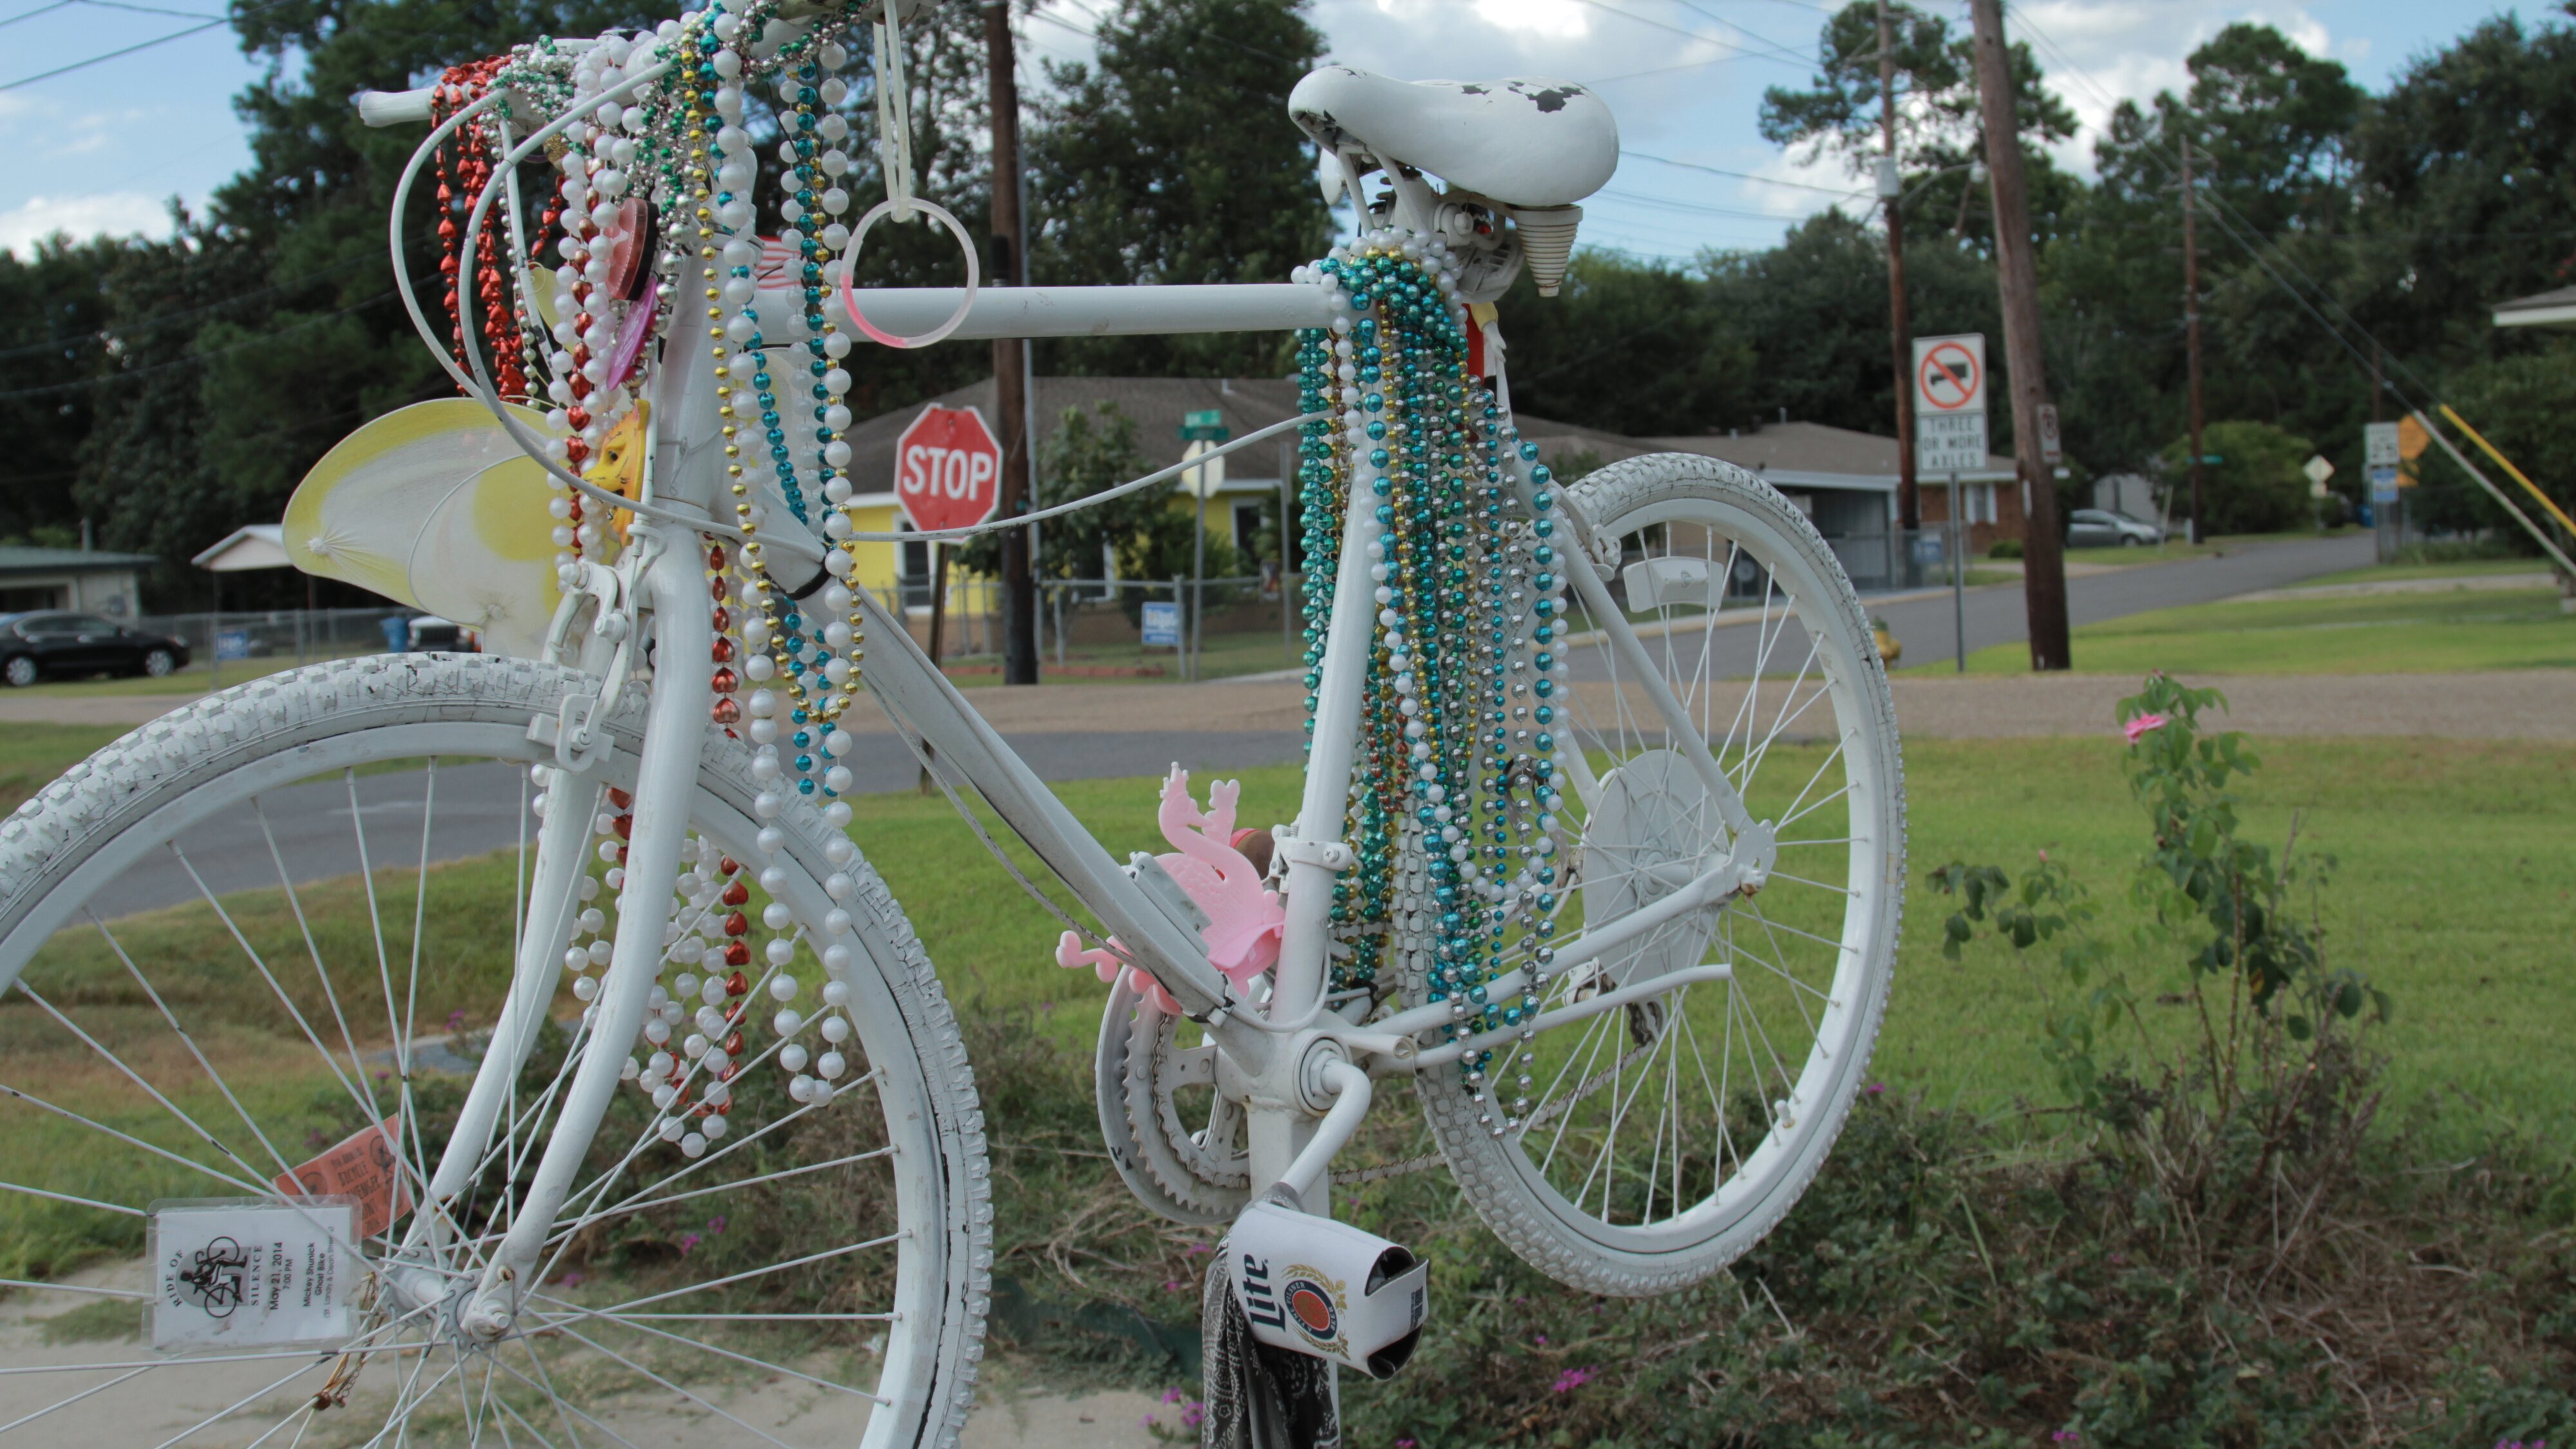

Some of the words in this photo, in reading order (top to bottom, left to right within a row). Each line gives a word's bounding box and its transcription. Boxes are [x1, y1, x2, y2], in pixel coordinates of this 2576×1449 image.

[1929, 416, 1974, 432] THREE
[1924, 437, 1939, 451] OR
[1947, 434, 1983, 449] MORE
[1932, 453, 1976, 467] AXLES
[904, 444, 994, 501] STOP
[169, 1249, 184, 1267] OF
[272, 1242, 283, 1266] 2014
[284, 1259, 293, 1271] PM
[305, 1242, 315, 1275] Shunick
[317, 1253, 325, 1271] Bike
[251, 1245, 263, 1306] SILENCE
[270, 1269, 282, 1284] 21,
[283, 1274, 292, 1289] 7:00
[315, 1273, 325, 1296] Ghost
[166, 1274, 183, 1307] RIDE
[269, 1287, 281, 1310] May
[303, 1278, 314, 1307] Mickey
[1242, 1254, 1285, 1332] Lite
[1286, 1282, 1305, 1305] PILSNER
